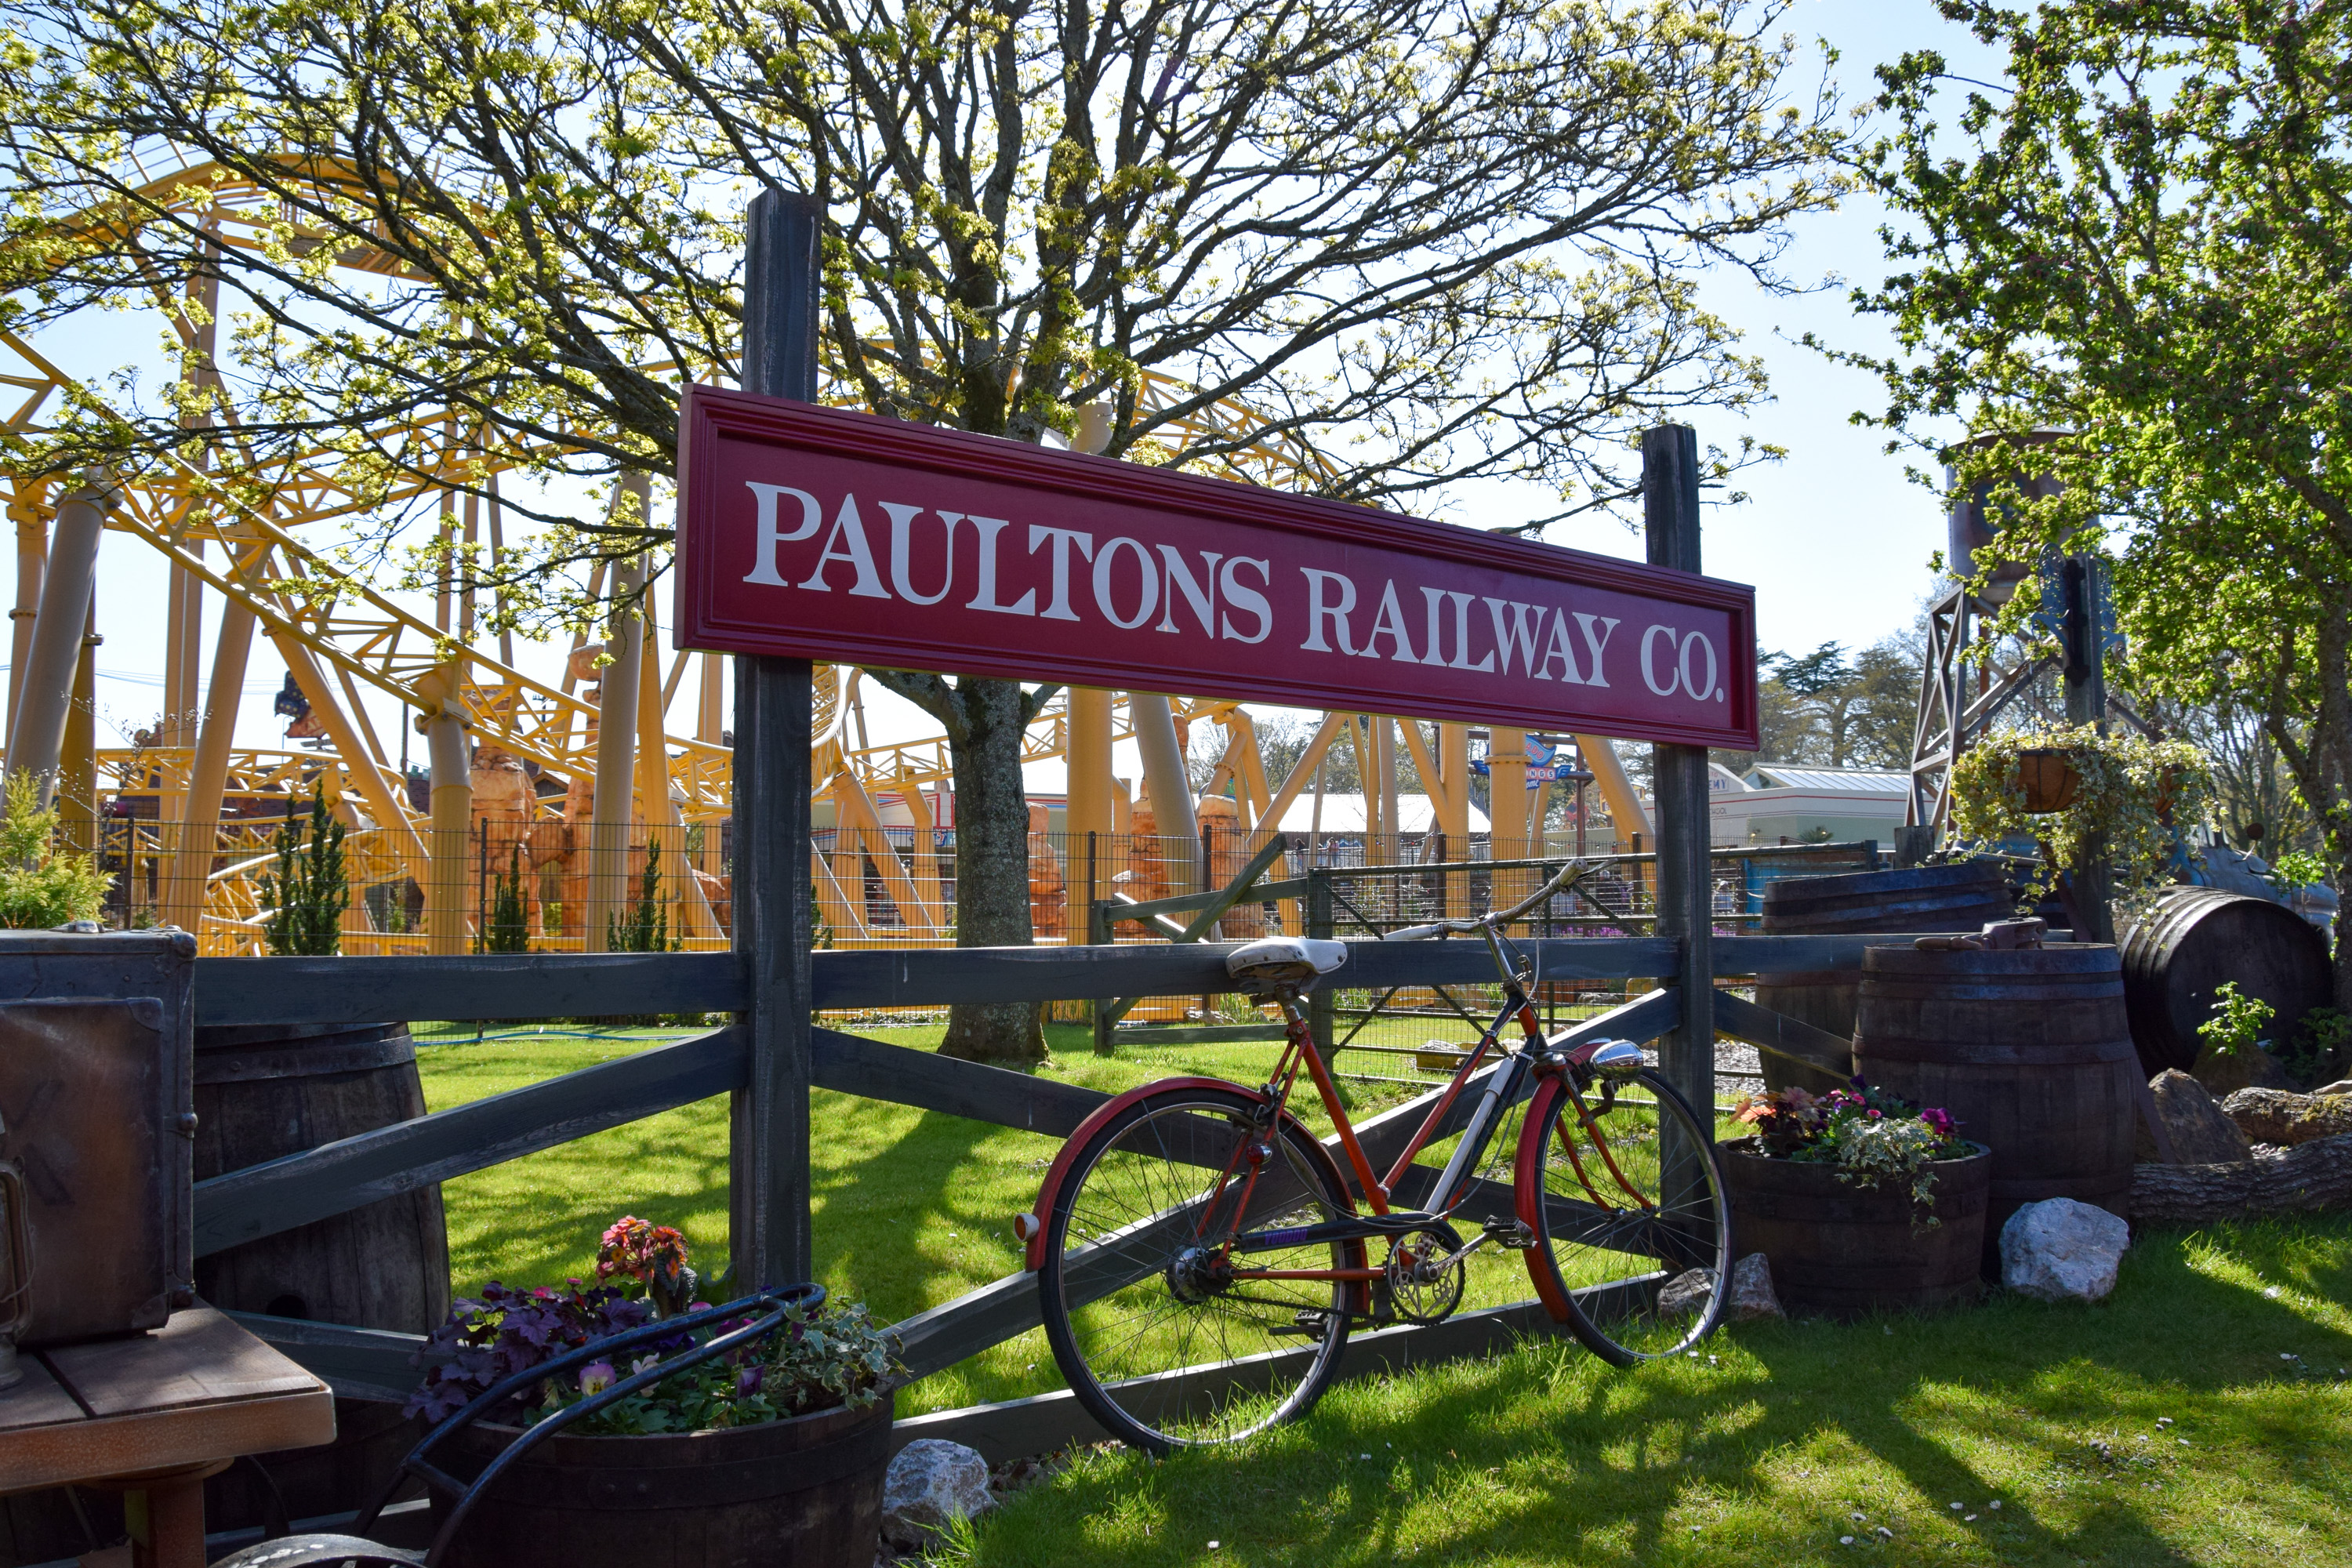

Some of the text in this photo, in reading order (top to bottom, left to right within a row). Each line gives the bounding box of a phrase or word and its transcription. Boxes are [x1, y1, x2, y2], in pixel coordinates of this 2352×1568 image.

[742, 481, 1724, 702] PAULTONS RAILWAY CO.
